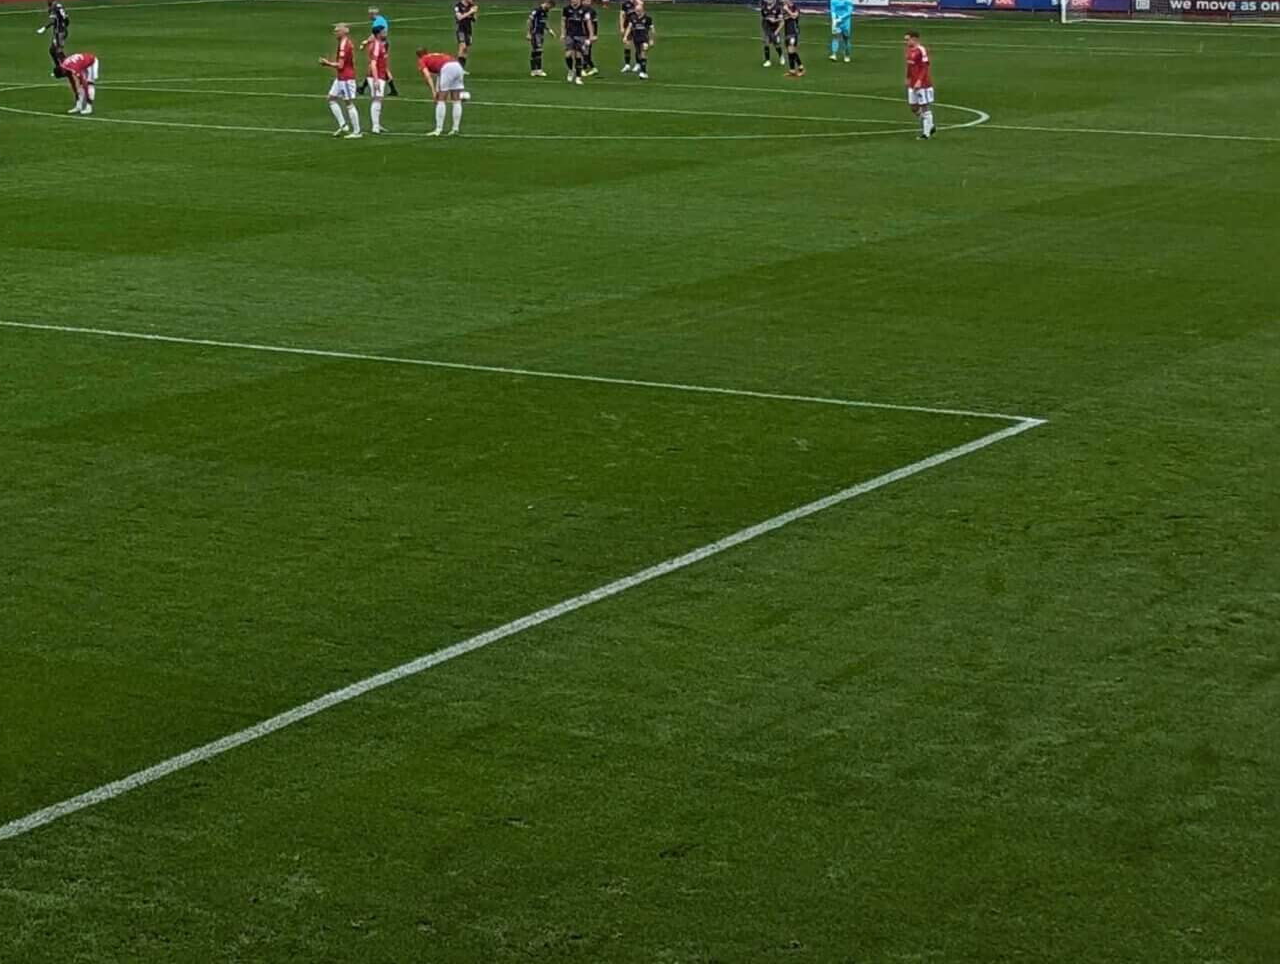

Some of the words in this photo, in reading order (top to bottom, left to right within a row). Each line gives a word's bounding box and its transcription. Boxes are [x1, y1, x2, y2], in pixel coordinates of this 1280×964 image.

[1169, 0, 1192, 9] we
[1196, 0, 1236, 11] move
[1240, 1, 1257, 11] as
[1261, 1, 1280, 11] on
